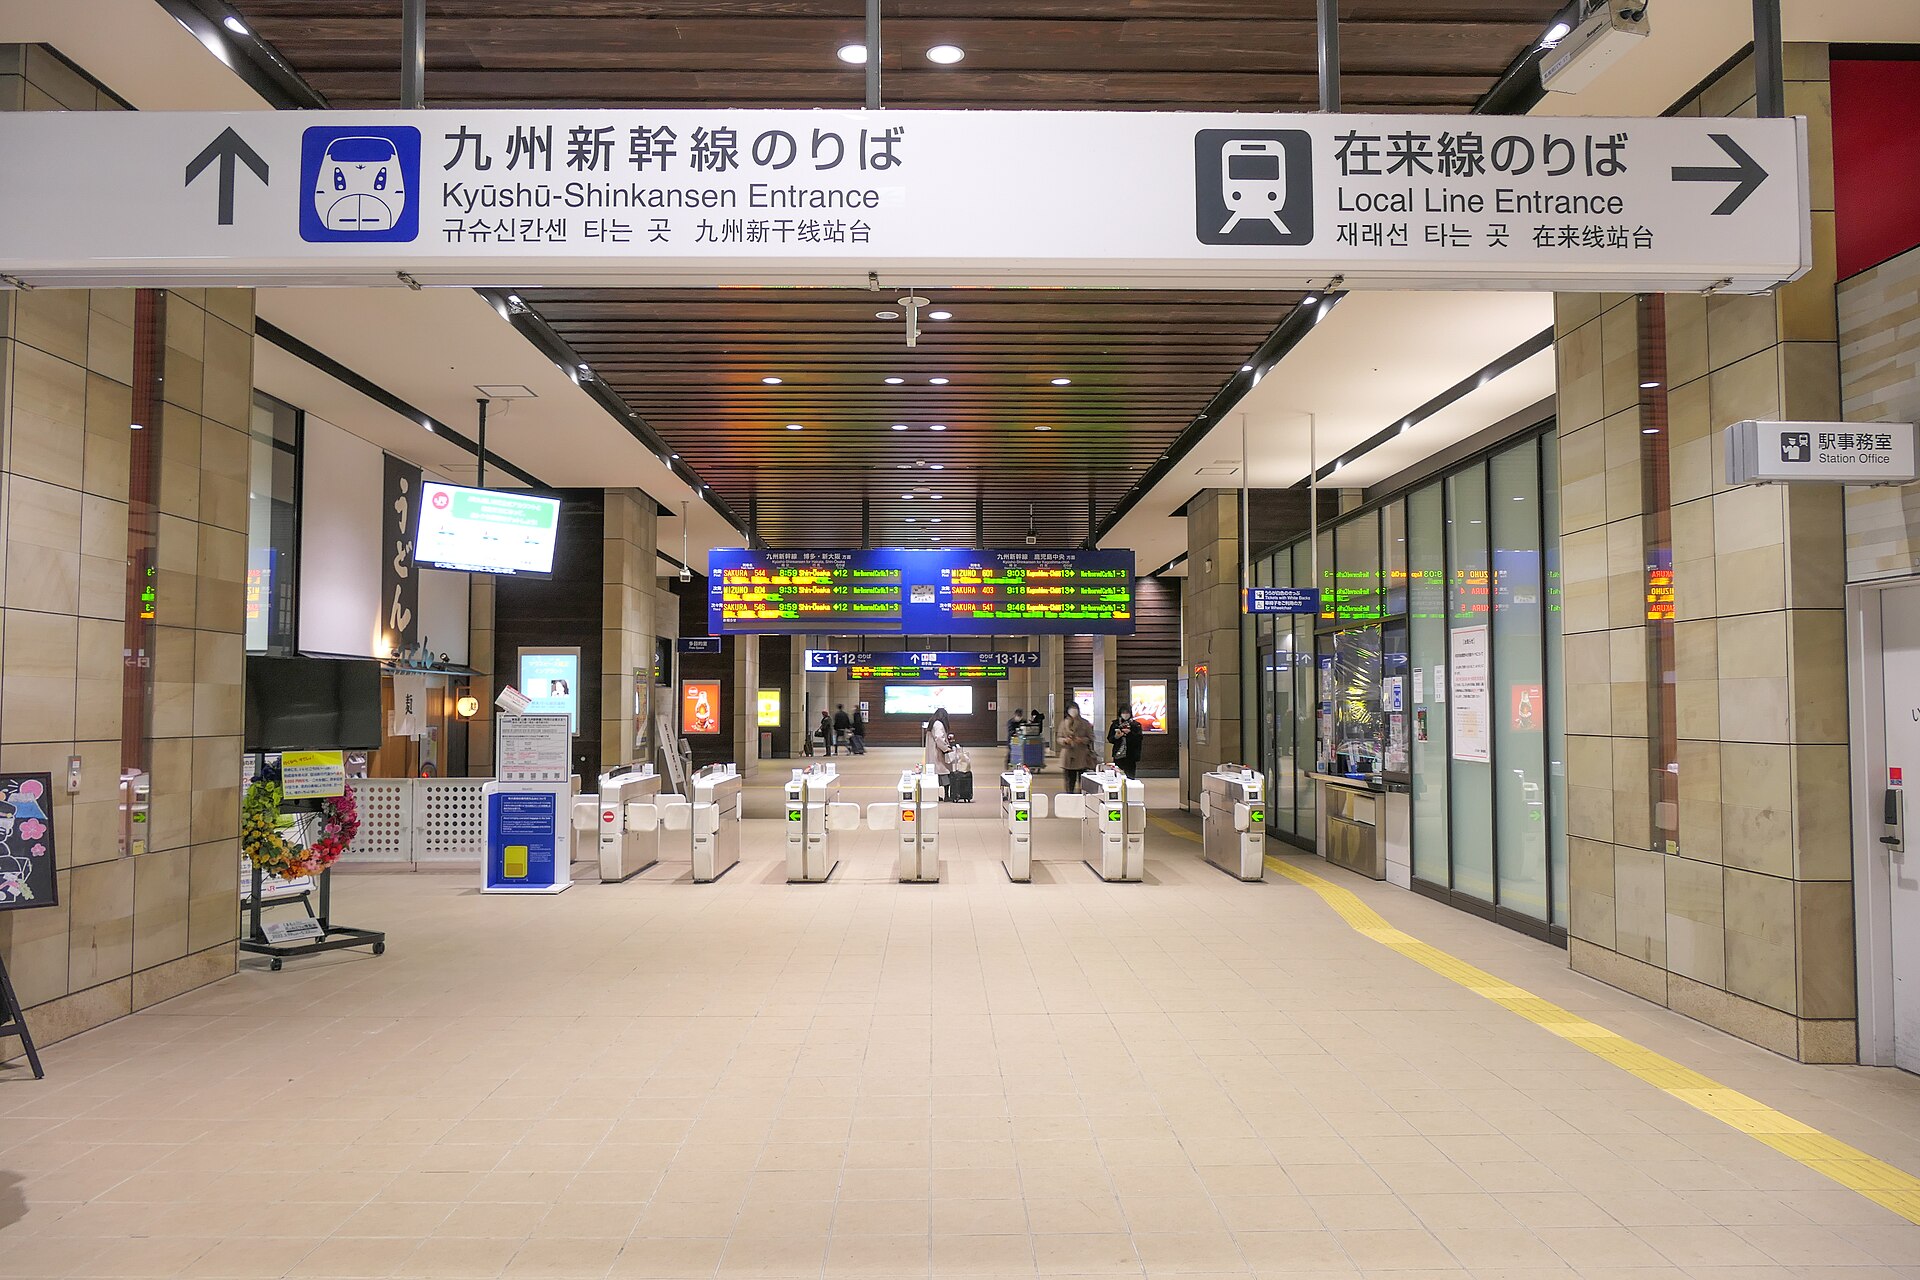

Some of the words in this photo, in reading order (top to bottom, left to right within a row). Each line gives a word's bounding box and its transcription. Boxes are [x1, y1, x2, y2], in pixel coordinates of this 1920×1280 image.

[443, 125, 905, 172] 九州新幹線のりば
[1333, 129, 1629, 178] 在来線のりば
[443, 182, 736, 214] Kyūshū-Shinkansen
[749, 183, 879, 209] Entrance
[1338, 186, 1413, 213] Local
[1425, 187, 1484, 213] Line
[1495, 188, 1624, 215] Entrance
[442, 218, 567, 243] 규슈신칸센
[584, 218, 633, 243] 타는
[647, 218, 672, 243] 곳
[694, 218, 871, 243] 九州新干线站台
[1336, 222, 1408, 247] 재래선
[1424, 222, 1473, 248] 타는
[1486, 223, 1510, 248] 곳
[1532, 224, 1654, 250] 在来线站台
[1818, 432, 1893, 451] 駅事務室
[1818, 453, 1856, 464] Station
[1858, 453, 1890, 464] Office
[390, 477, 413, 632] うどん
[723, 569, 748, 577] SAKURA
[779, 569, 798, 577] 8:59
[839, 569, 848, 577] 12
[951, 569, 976, 577] MIZUHO
[1006, 569, 1026, 577] 9:03
[723, 586, 748, 594] MIZUHO
[779, 586, 798, 594] 9:33
[839, 586, 848, 594] 12
[951, 586, 976, 594] SAKURA
[1006, 586, 1026, 594] 9:18
[723, 603, 748, 611] SAKURA
[778, 603, 798, 611] 9:59
[839, 603, 848, 611] 12
[951, 603, 976, 611] SAKURA
[1006, 603, 1026, 611] 9:46
